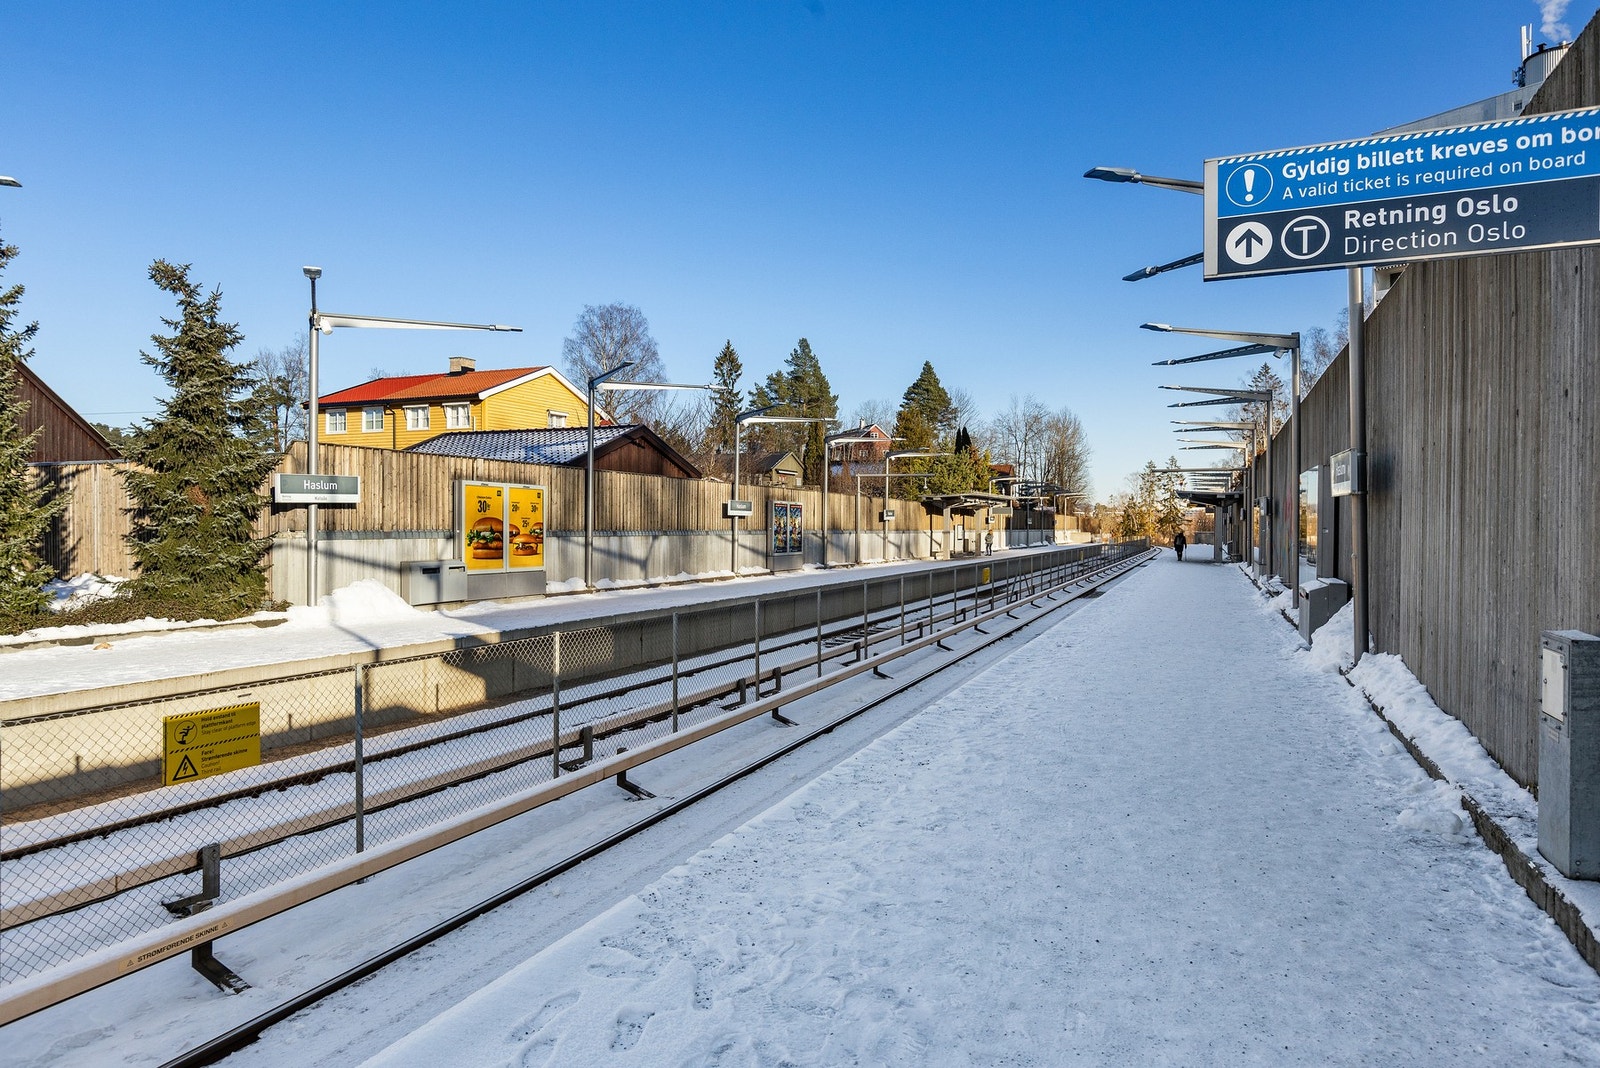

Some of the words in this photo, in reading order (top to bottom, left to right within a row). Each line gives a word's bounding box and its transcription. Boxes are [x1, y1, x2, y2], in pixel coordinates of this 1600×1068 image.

[1282, 157, 1351, 180] Gyldig
[1357, 148, 1425, 171] billett
[1431, 141, 1508, 161] kreves
[1520, 133, 1553, 149] om
[1282, 187, 1294, 200] A
[1298, 178, 1337, 198] valid
[1343, 174, 1391, 193] ticket
[1396, 171, 1411, 187] is
[1415, 162, 1493, 184] required
[1500, 159, 1523, 174] on
[1529, 151, 1586, 171] board
[1344, 203, 1448, 230] Retning
[1456, 194, 1519, 217] Oslo
[1344, 230, 1458, 256] Direction
[1467, 222, 1526, 244] Oslo
[303, 480, 338, 490] Haslum
[477, 500, 487, 513] 30
[137, 935, 195, 963] STRØMFØRENDE
[195, 925, 219, 939] SKINNE
